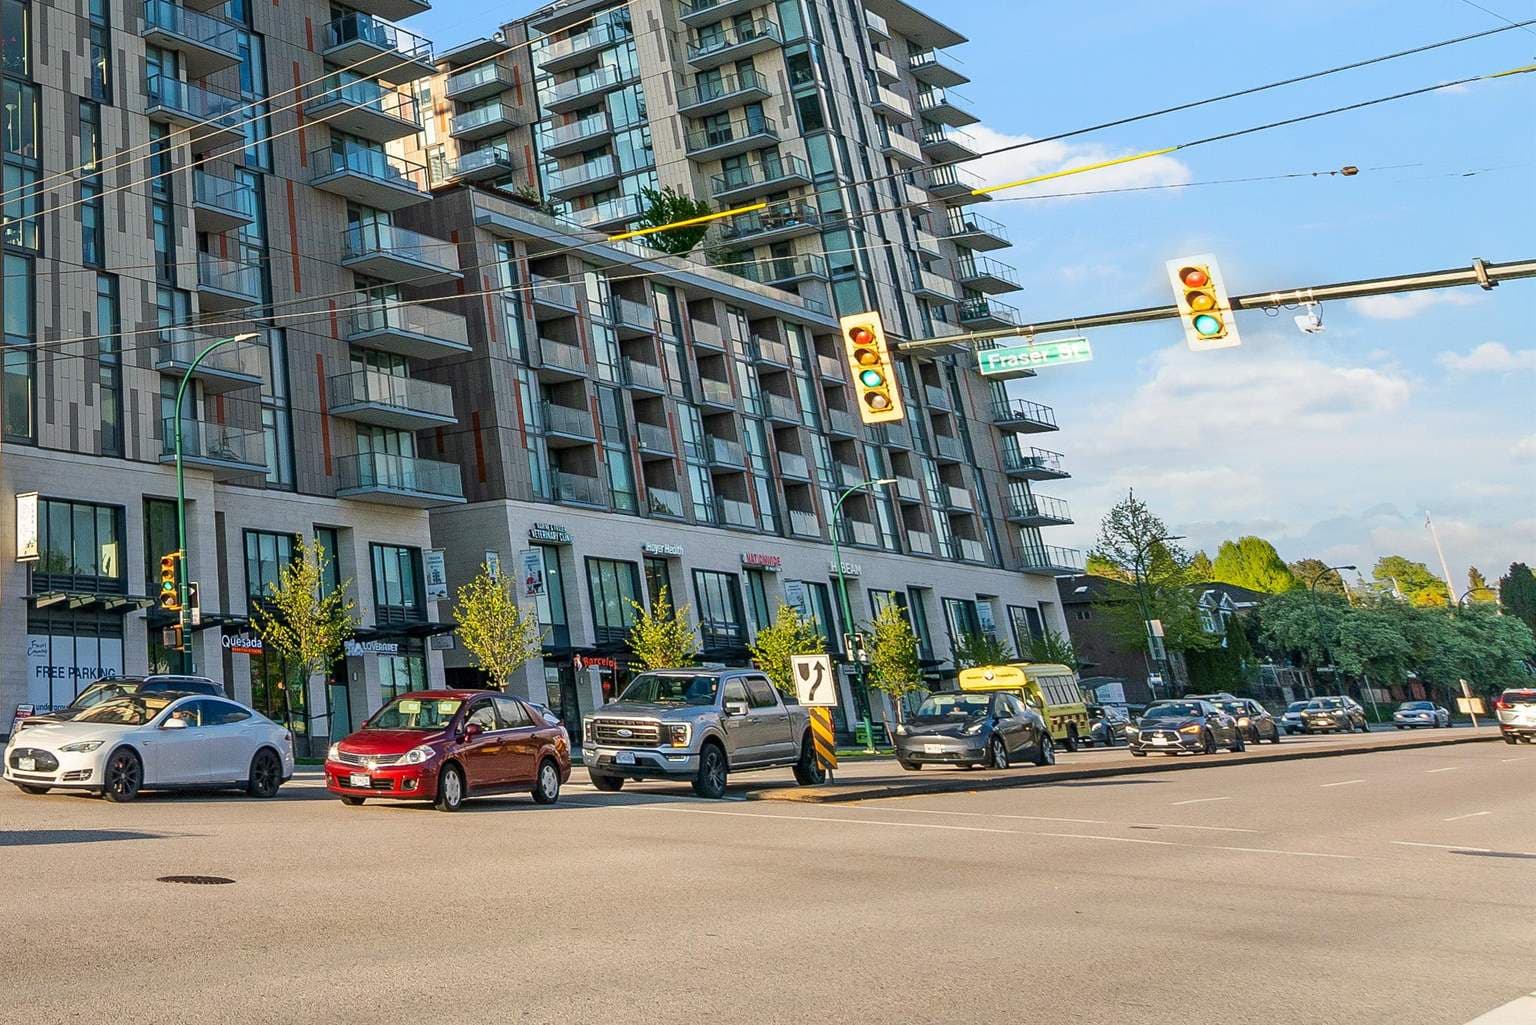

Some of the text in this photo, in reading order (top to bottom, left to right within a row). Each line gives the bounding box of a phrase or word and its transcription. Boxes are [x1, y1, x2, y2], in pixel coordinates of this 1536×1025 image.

[987, 350, 1048, 369] Fraser
[221, 634, 263, 648] Quesada
[36, 666, 116, 679] FREE PARKNG
